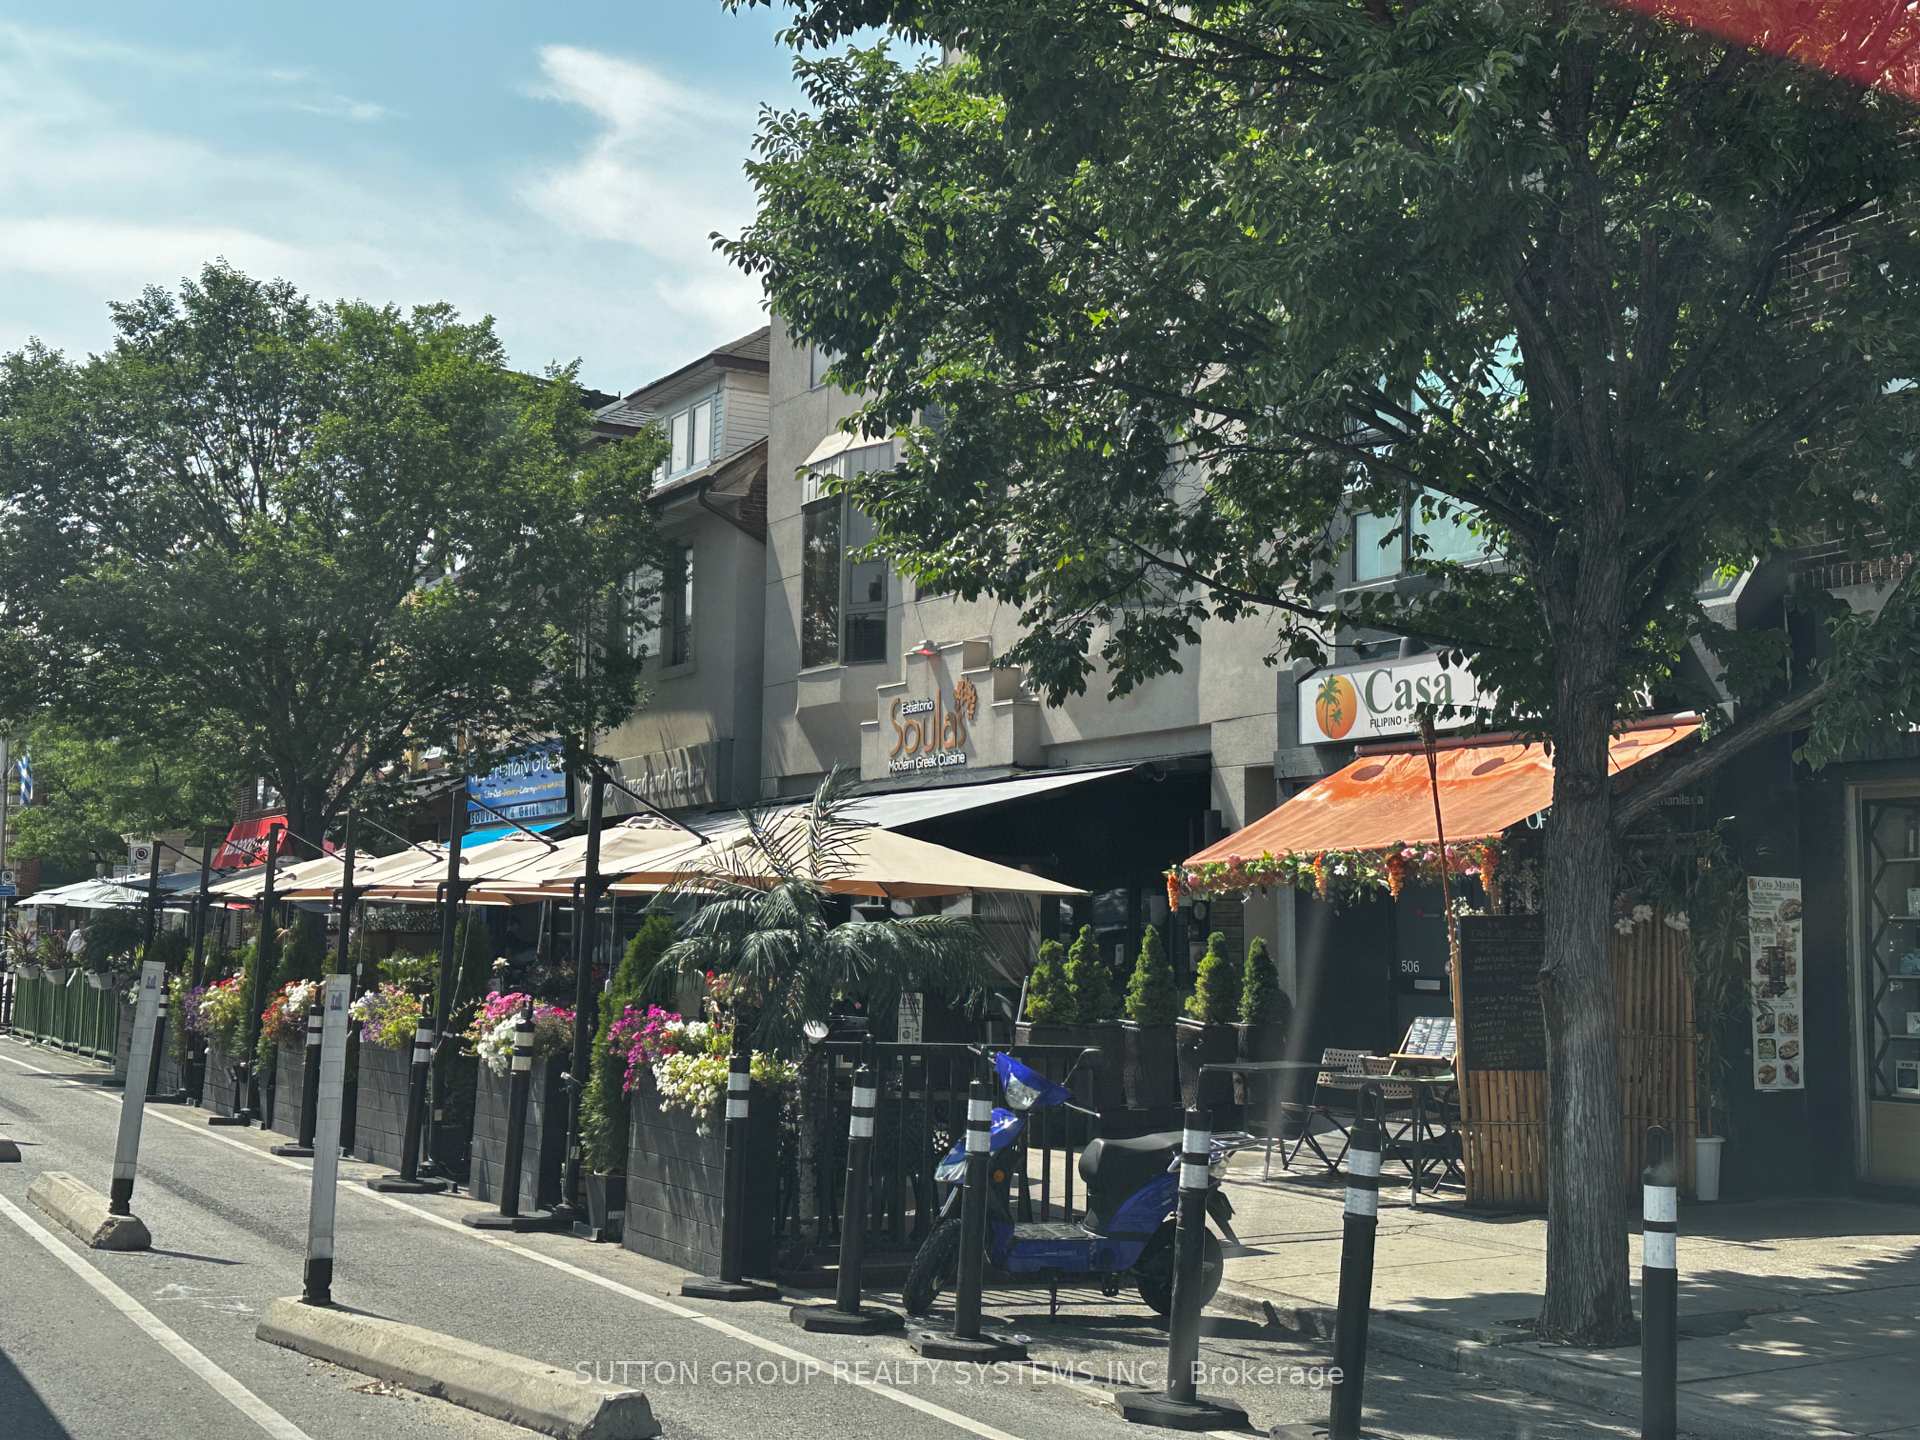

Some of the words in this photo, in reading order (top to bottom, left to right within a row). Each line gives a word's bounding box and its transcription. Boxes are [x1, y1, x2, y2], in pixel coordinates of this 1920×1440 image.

[1365, 668, 1454, 714] Casa
[1370, 717, 1402, 728] FILIPINO
[888, 758, 914, 772] Modern
[916, 755, 937, 769] Greek
[938, 752, 966, 766] Cuisine
[1401, 960, 1420, 973] 506
